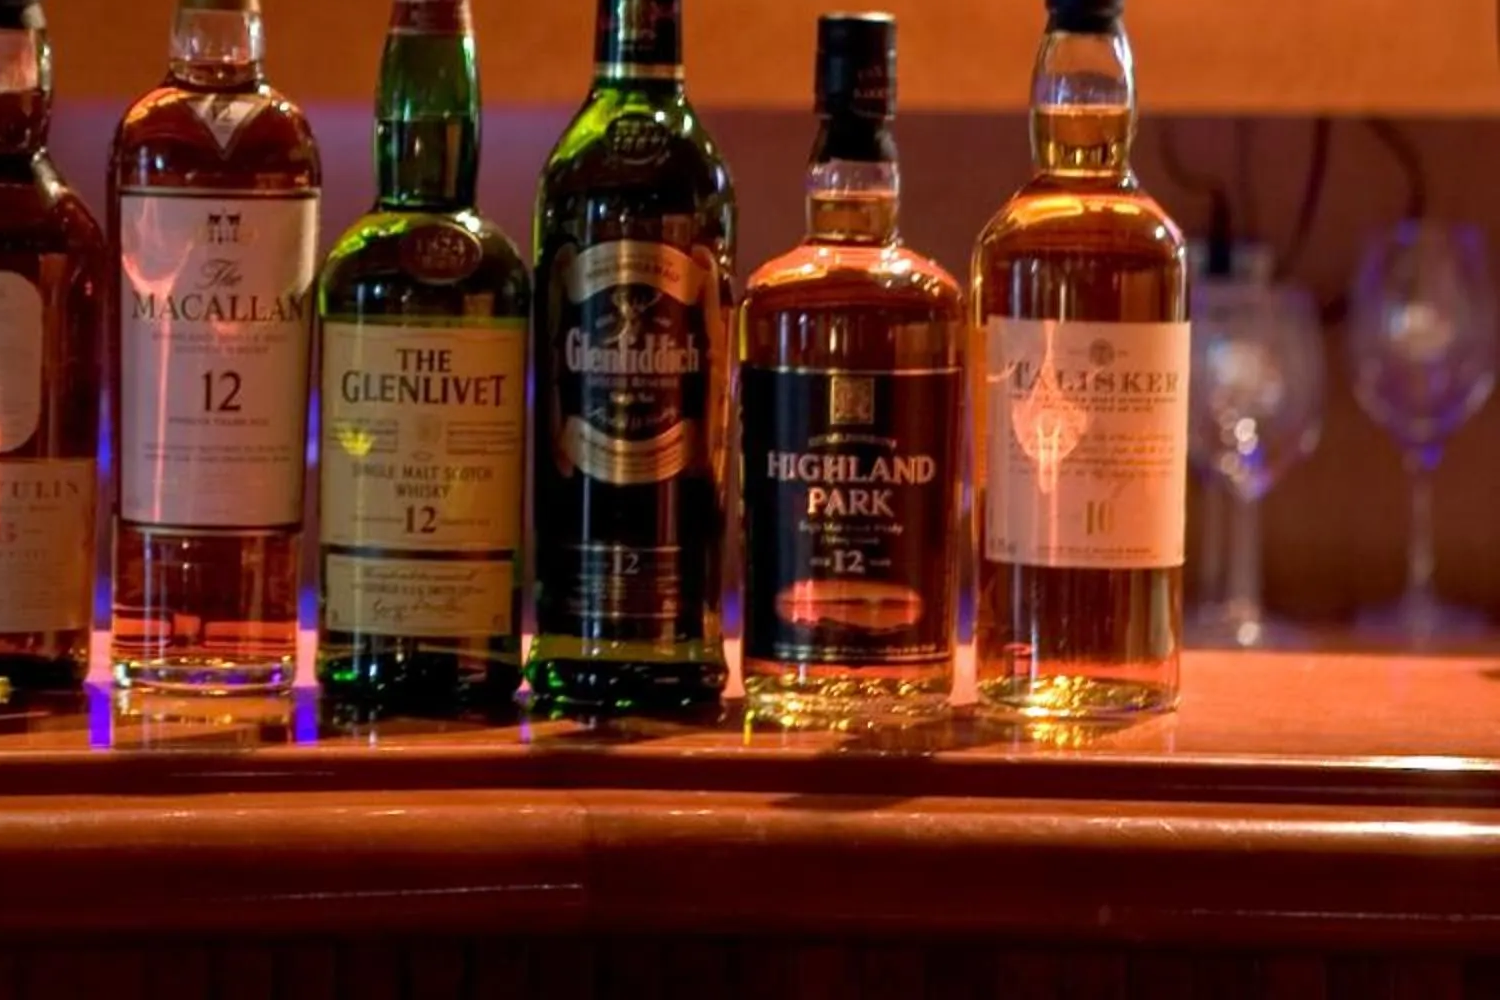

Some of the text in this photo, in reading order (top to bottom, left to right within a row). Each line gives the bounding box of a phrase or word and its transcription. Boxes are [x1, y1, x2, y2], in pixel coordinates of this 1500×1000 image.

[196, 258, 242, 289] The
[131, 293, 303, 322] MACALLAN
[396, 348, 452, 373] THE
[565, 327, 700, 374] Glenfiddich
[201, 369, 242, 412] 12
[341, 370, 507, 407] GLENLIVET
[1009, 359, 1180, 394] TALISKER
[766, 450, 936, 484] HIGHLAND
[807, 486, 894, 517] PARK
[405, 505, 438, 534] 12
[613, 550, 641, 575] 12
[833, 550, 866, 573] 12
